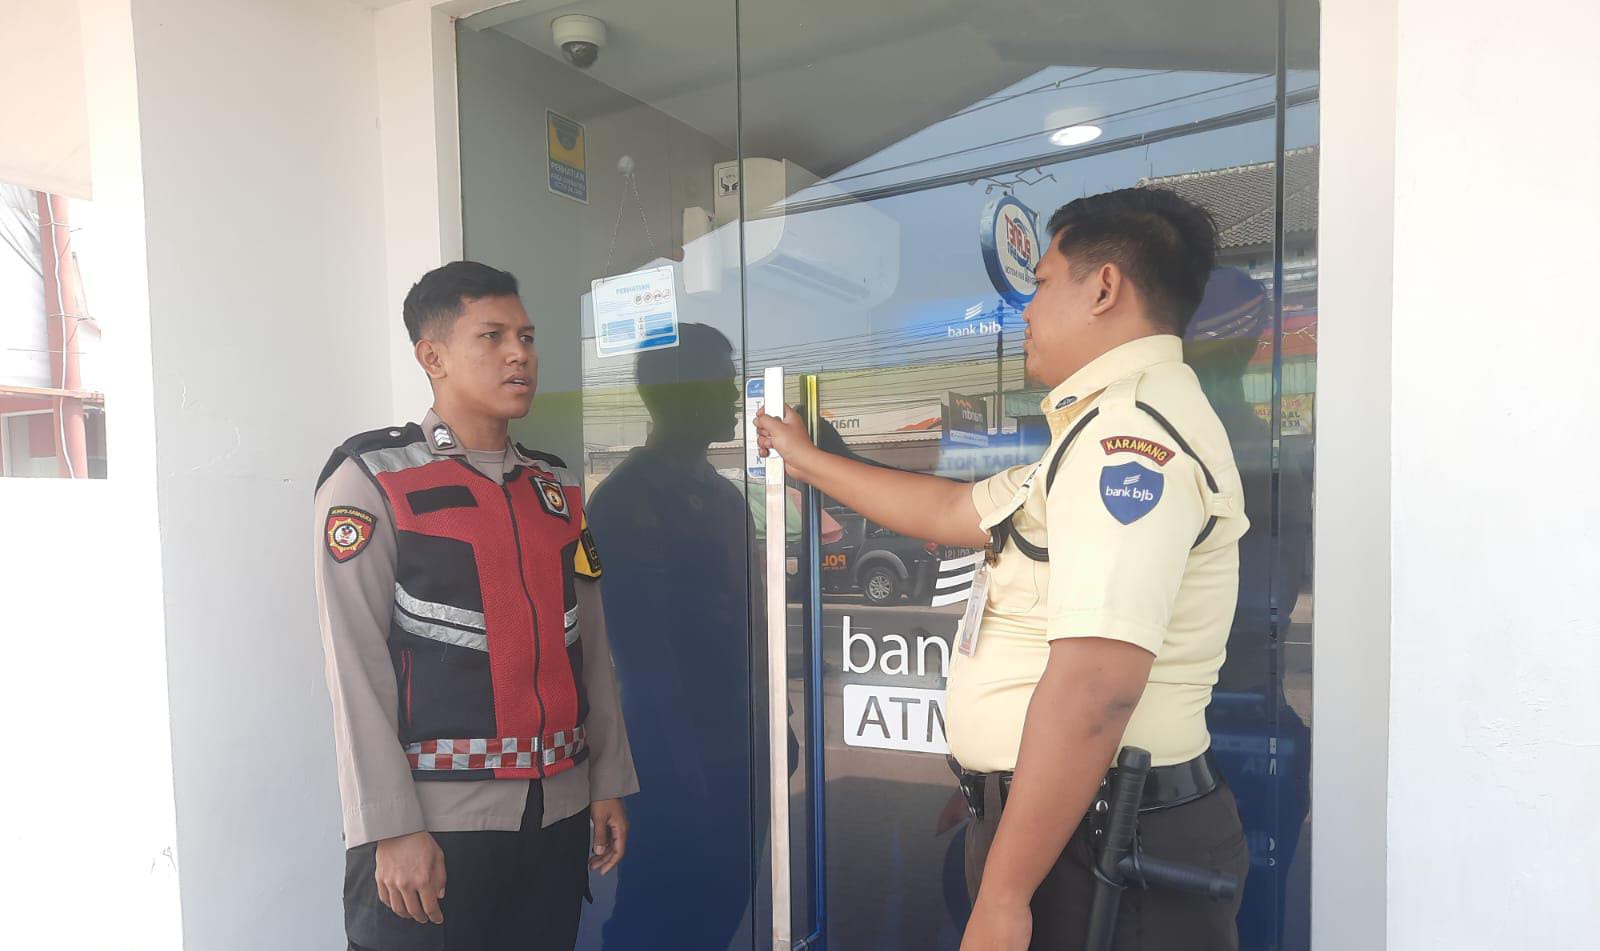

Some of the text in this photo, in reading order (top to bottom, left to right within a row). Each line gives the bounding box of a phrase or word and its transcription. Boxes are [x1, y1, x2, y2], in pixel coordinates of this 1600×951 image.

[615, 282, 651, 295] PERHATIAN
[947, 323, 977, 337] bank
[1106, 438, 1168, 461] KARAWANG
[1105, 485, 1154, 502] bank bjb
[842, 615, 951, 678] ban
